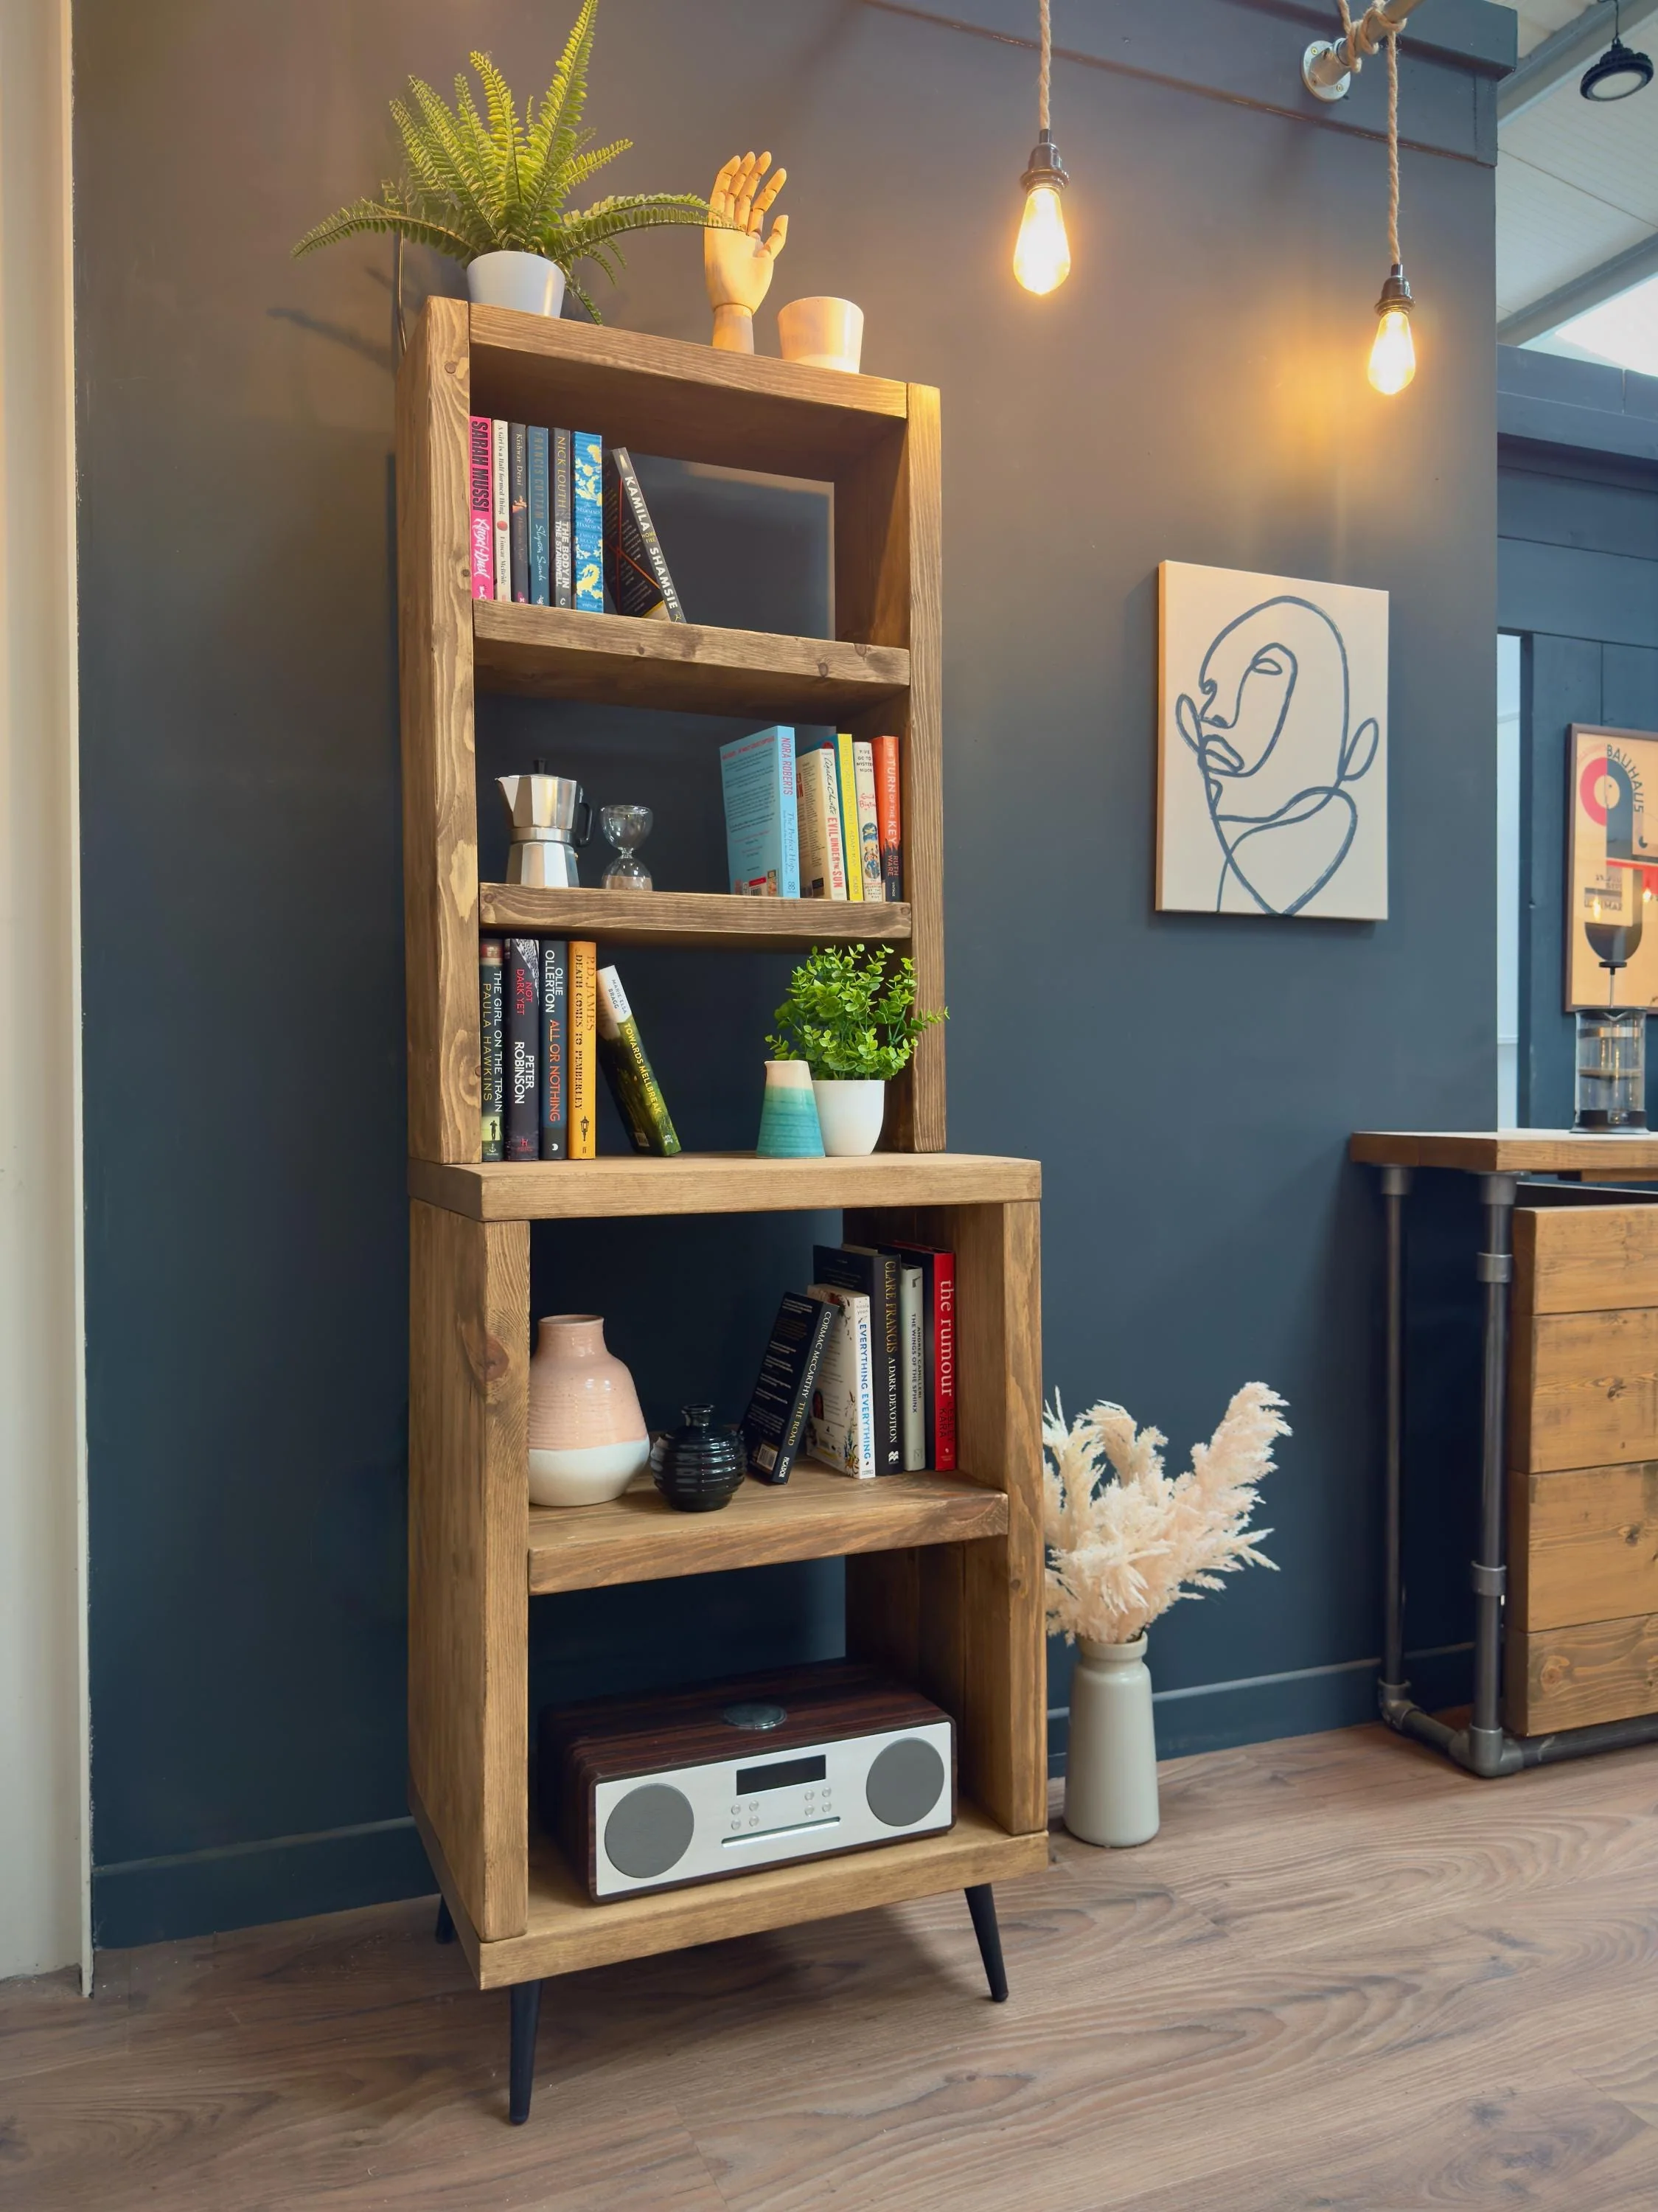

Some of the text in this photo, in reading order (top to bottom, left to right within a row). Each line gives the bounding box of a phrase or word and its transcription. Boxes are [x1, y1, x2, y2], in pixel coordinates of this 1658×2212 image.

[472, 421, 490, 512] SARAH MUSSI
[534, 431, 545, 519] FRANCIS COTTAM
[557, 436, 566, 508] NICK LOUTH
[625, 476, 650, 532] KAMILA
[472, 518, 490, 578] Angel Dust
[562, 577, 570, 588] IN
[650, 547, 678, 609] SHAMSIE
[781, 737, 793, 796] NORA ROBERTS
[887, 759, 896, 793] TURN
[1606, 743, 1644, 813] BAUHAUS
[827, 817, 838, 837] EVIL
[831, 838, 840, 862] UNDER
[888, 821, 896, 844] KEY
[832, 871, 843, 888] SUN
[516, 969, 525, 1015] DARK YET
[525, 981, 533, 1003] NOT
[545, 950, 555, 1013] OLLERTON
[555, 967, 563, 996] OLLIE
[608, 988, 619, 1009] BRAGG
[494, 998, 502, 1026] GIRL
[585, 982, 595, 1031] JAMES
[483, 984, 492, 1101] PAULA HAWKINS
[494, 1030, 502, 1047] ON
[575, 1032, 582, 1046] TO
[515, 1041, 525, 1104] ROBINSON
[525, 1055, 534, 1089] PETER
[549, 1019, 560, 1121] ALL OR NOTHING
[624, 1023, 662, 1114] TOWARDS MELLBREAK
[495, 1077, 503, 1112] TRAIN
[816, 1311, 832, 1350] CORMAC
[885, 1261, 897, 1353] CLARE FRANCIS
[859, 1324, 868, 1390] EVERYTHING
[941, 1280, 955, 1397] the rumour
[787, 1420, 801, 1446] ROAD
[794, 1400, 806, 1419] THE
[862, 1393, 871, 1459] EVERYTHING
[889, 1394, 897, 1443] DEVOTION
[939, 1408, 947, 1438] KARA
